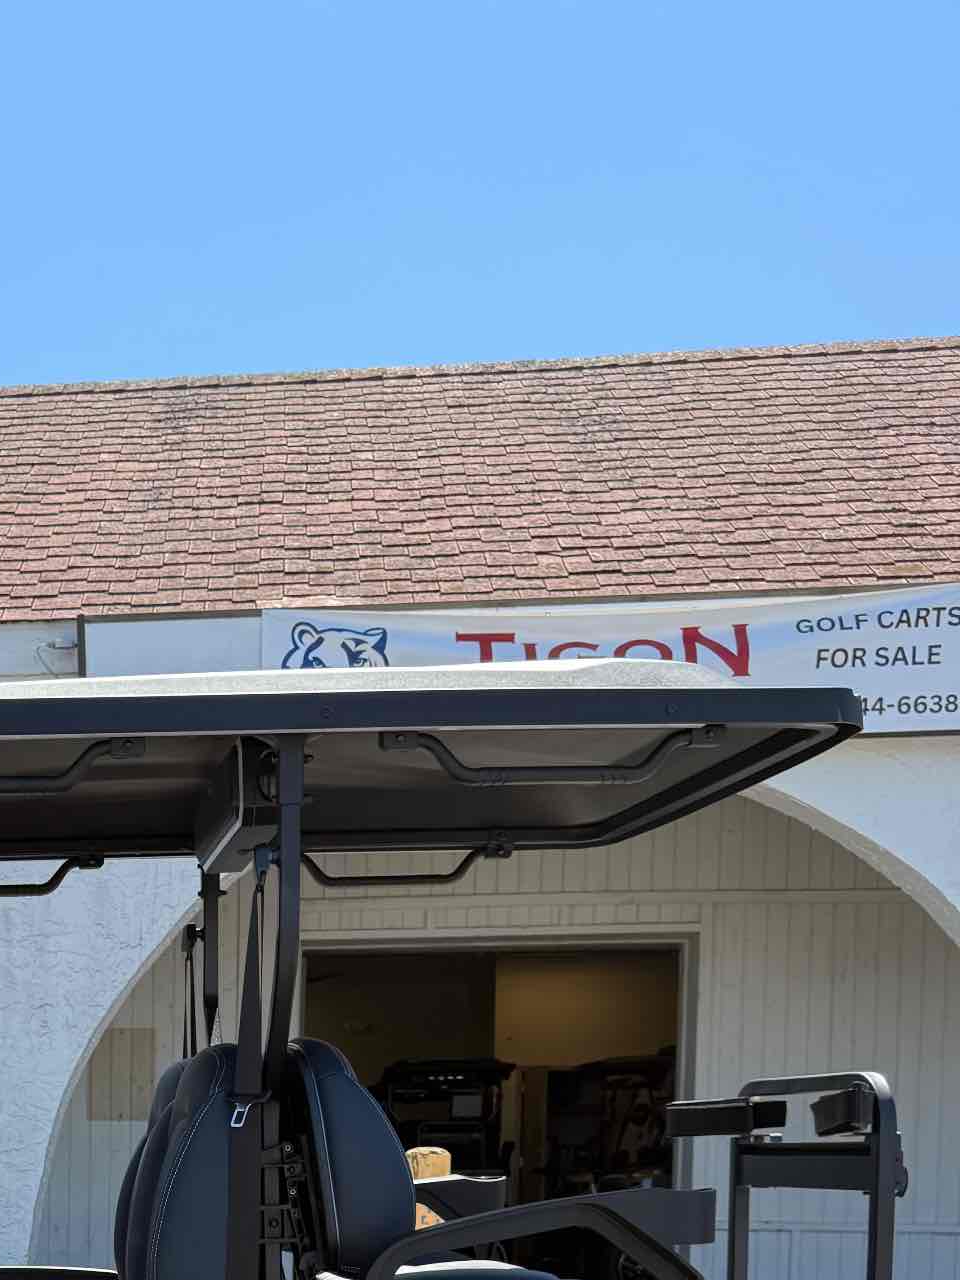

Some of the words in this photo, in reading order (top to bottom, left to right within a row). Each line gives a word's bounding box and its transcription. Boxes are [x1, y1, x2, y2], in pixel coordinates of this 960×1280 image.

[795, 613, 869, 633] GOLF
[877, 606, 960, 629] CARTS
[455, 623, 751, 678] TIGON
[816, 648, 866, 669] FOR
[874, 644, 942, 667] SALE
